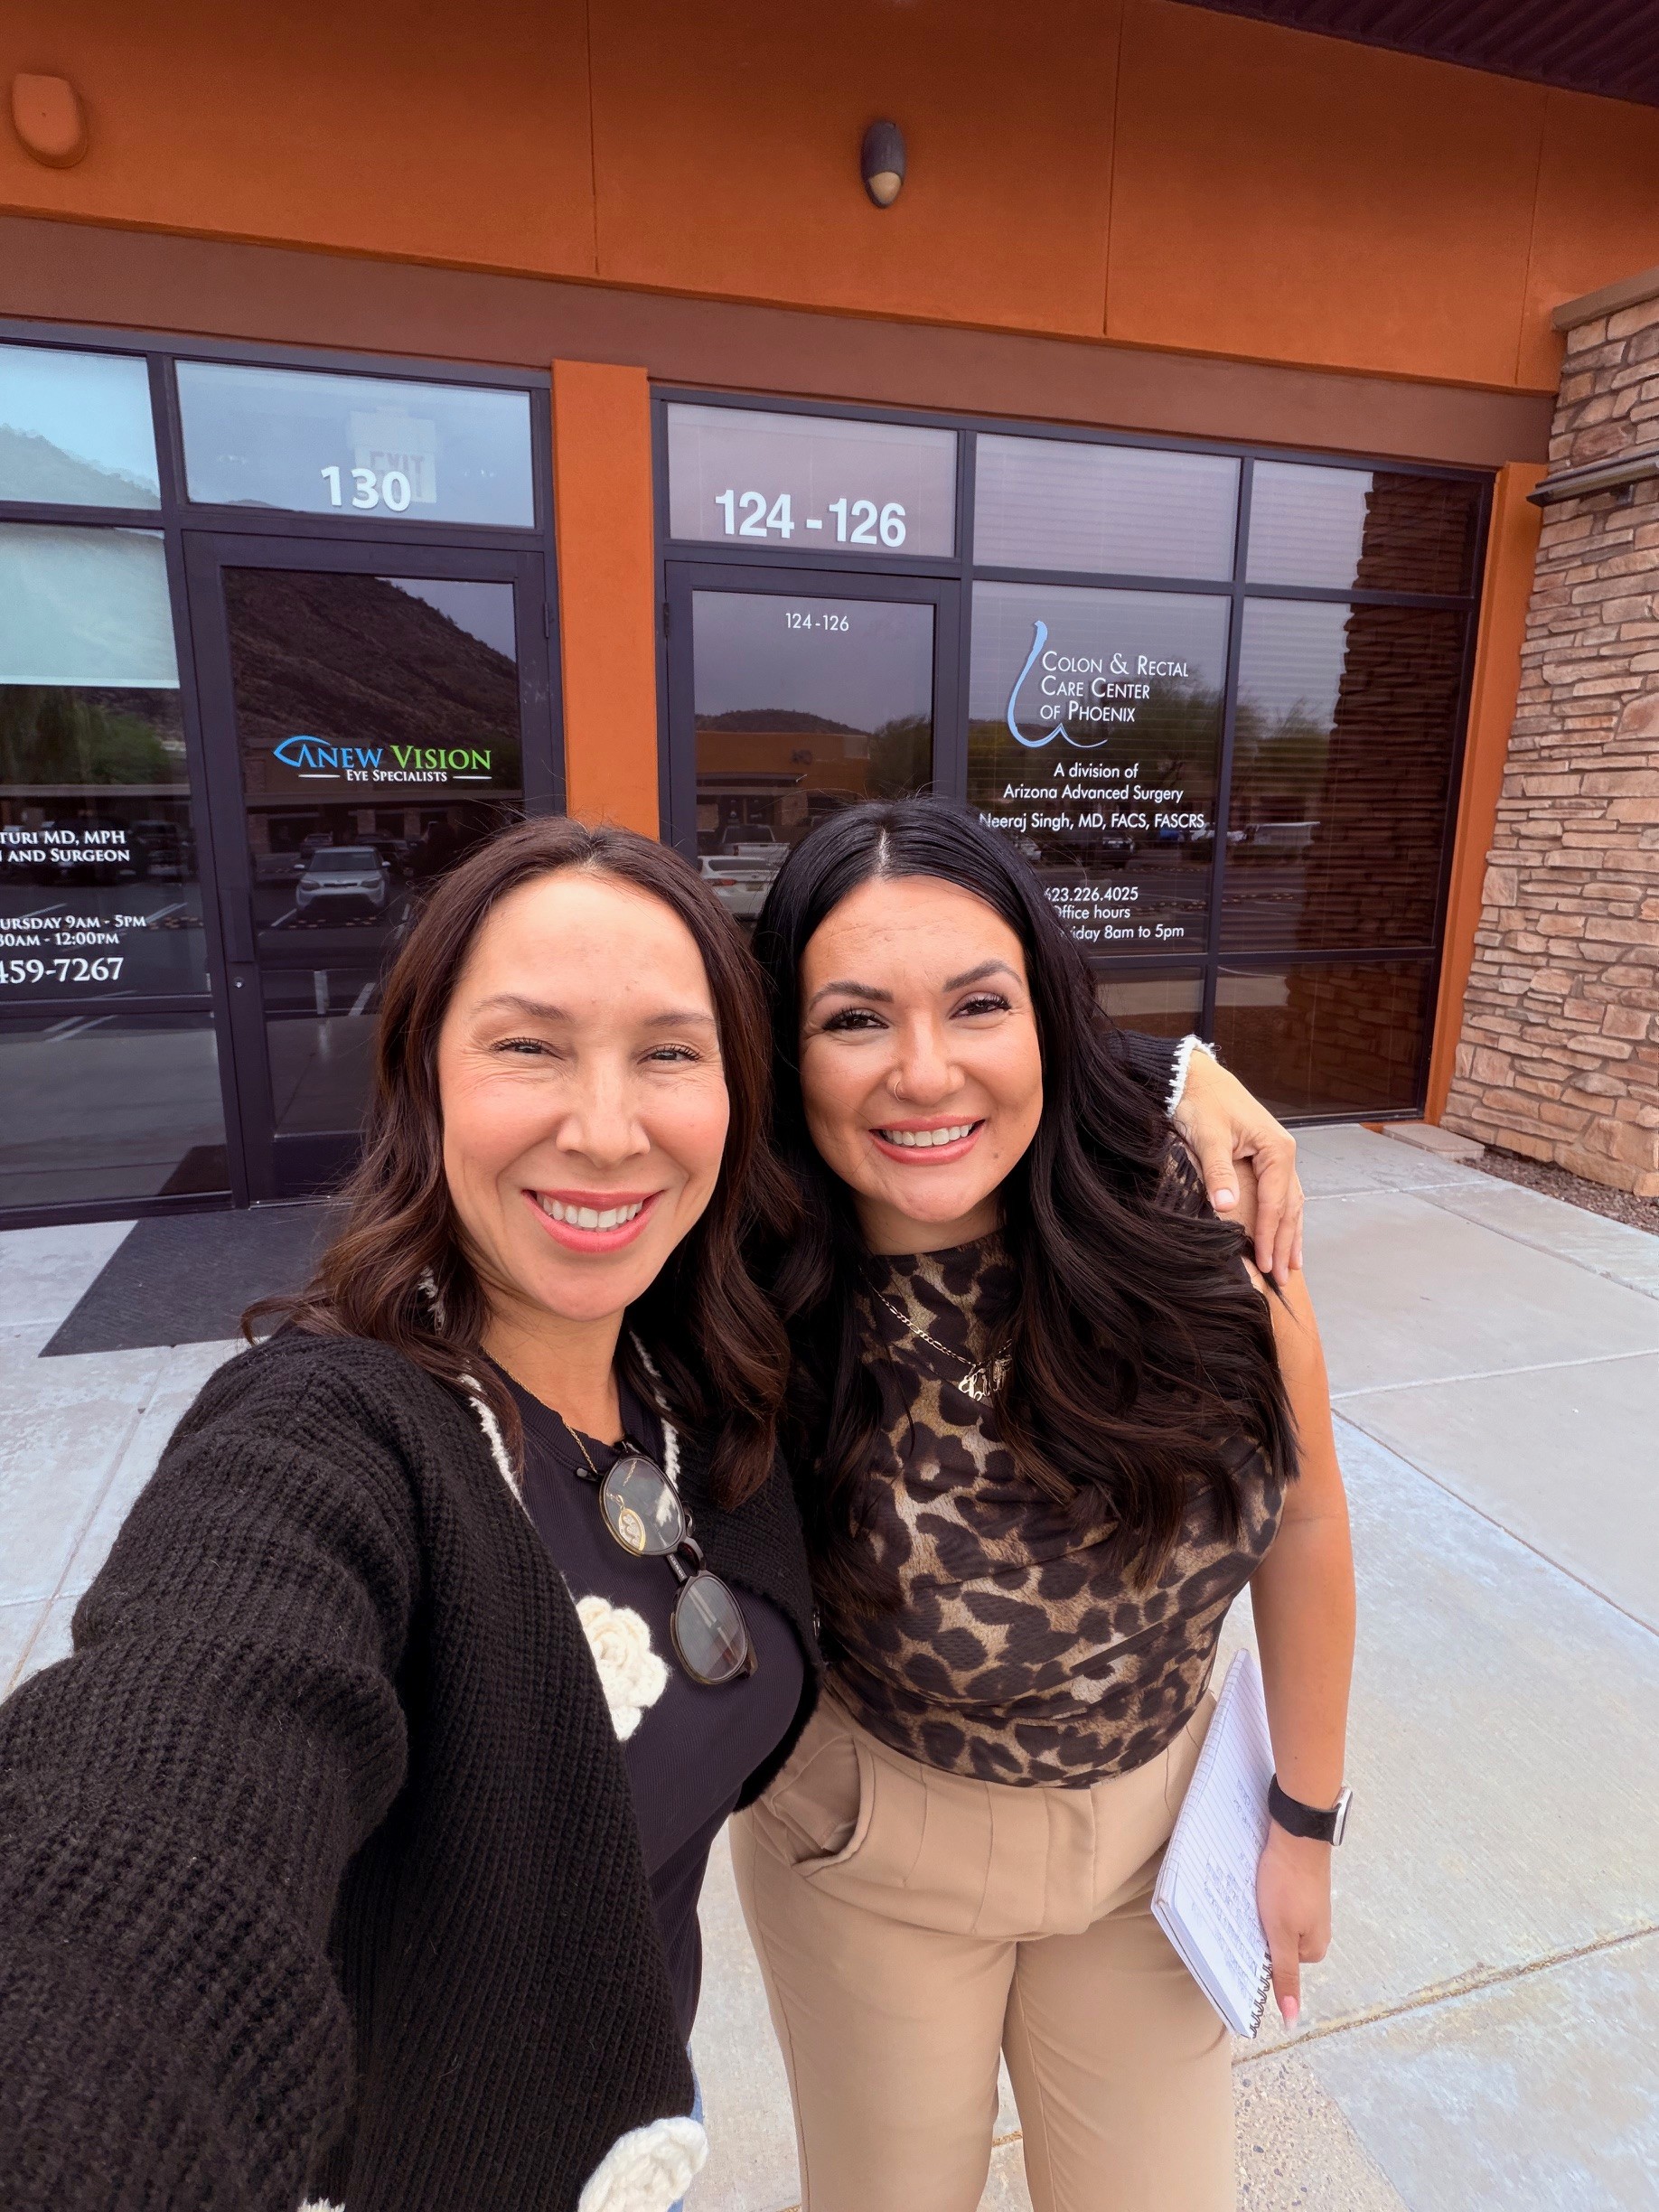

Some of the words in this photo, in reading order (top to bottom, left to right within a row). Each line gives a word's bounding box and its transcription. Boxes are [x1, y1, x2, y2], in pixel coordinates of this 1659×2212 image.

[321, 466, 411, 511] 130
[1110, 652, 1129, 675] &
[1054, 764, 1065, 777] A
[1069, 763, 1120, 778] division
[1124, 763, 1139, 779] of
[1003, 783, 1057, 799] Arizona
[1062, 783, 1129, 801] Advanced
[1133, 784, 1184, 803] Surgery
[979, 812, 1027, 833] Neeraj
[1031, 813, 1074, 831] Singh,
[1078, 813, 1107, 830] MD,
[1111, 813, 1150, 830] FACS,
[1154, 813, 1204, 829] FASCRS
[44, 830, 80, 846] MD,
[84, 830, 127, 845] MPH
[8, 849, 46, 863] AND
[1094, 904, 1131, 919] hours
[65, 914, 101, 929] 9AM
[114, 914, 146, 928] 5PM
[55, 932, 119, 946] 12:00PM
[1104, 925, 1134, 939] 8am
[1139, 925, 1151, 938] to
[1155, 924, 1185, 941] 5pm
